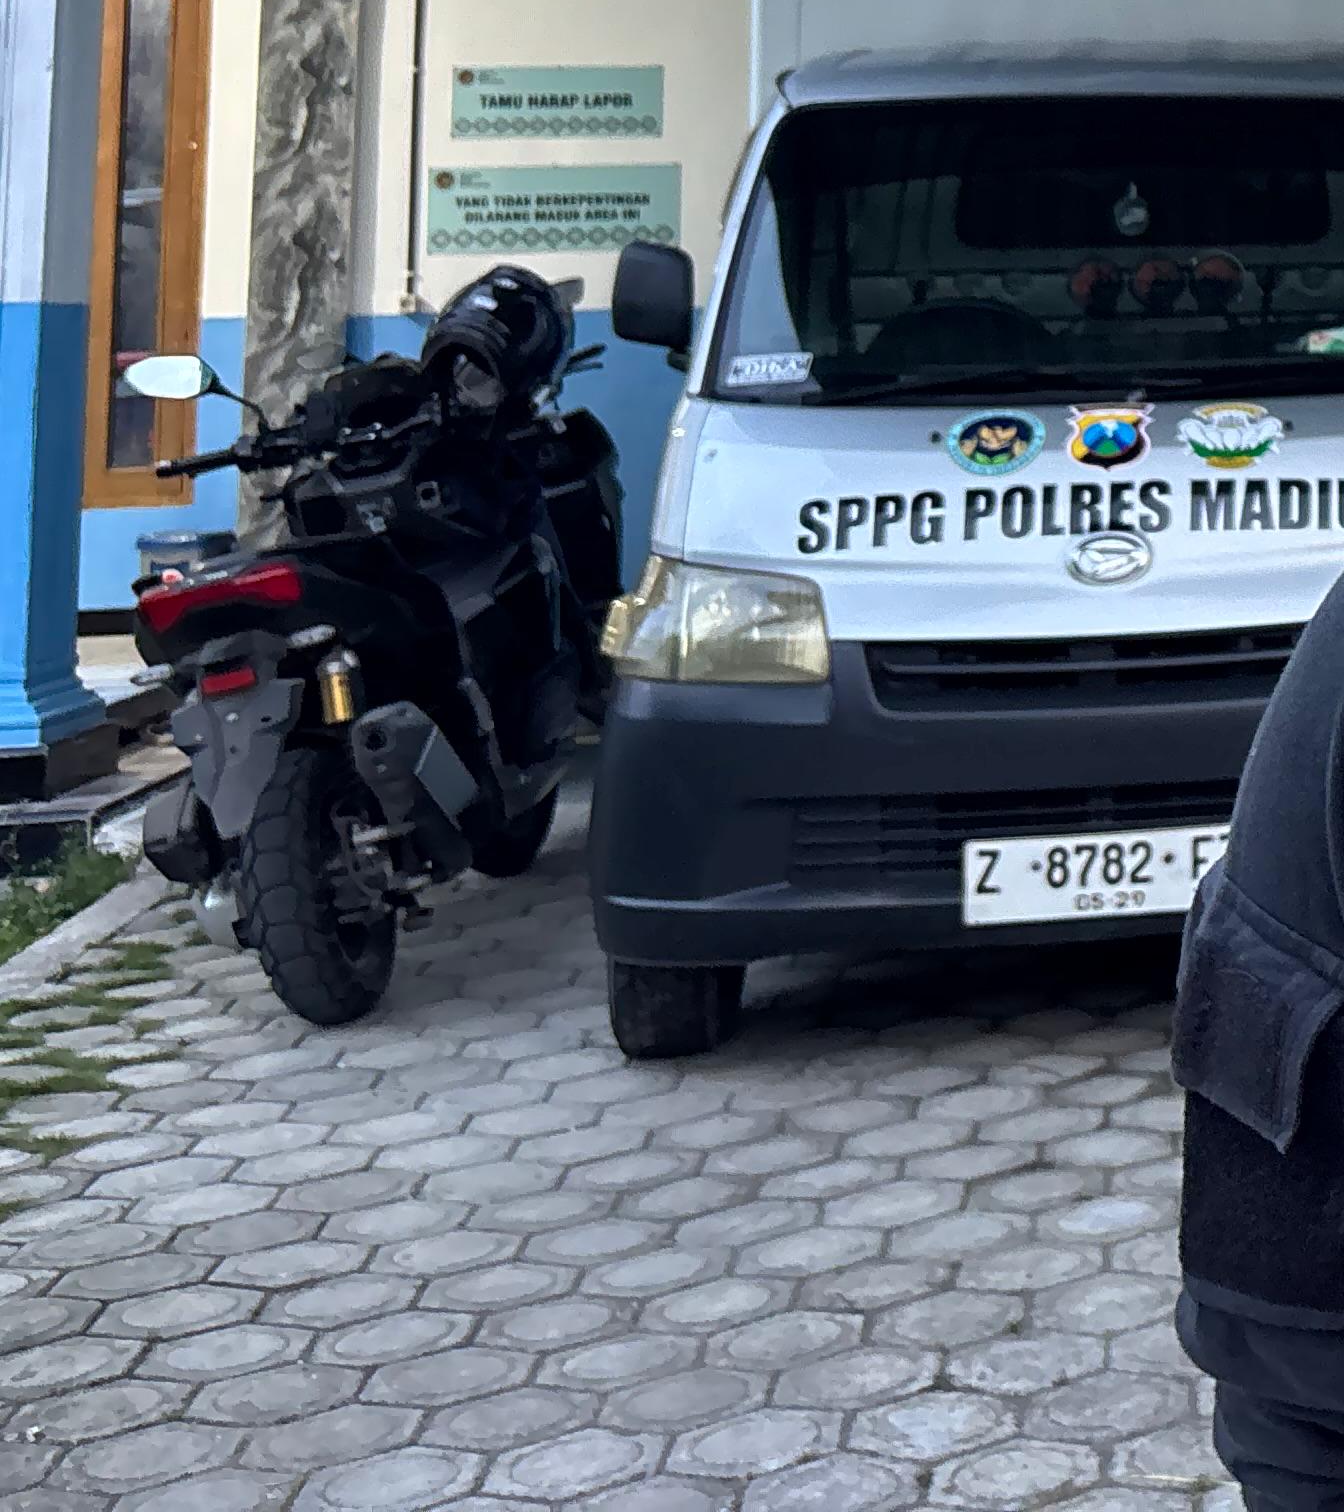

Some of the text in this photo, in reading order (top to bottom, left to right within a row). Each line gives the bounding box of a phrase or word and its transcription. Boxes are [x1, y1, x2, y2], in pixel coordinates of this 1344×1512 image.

[480, 93, 522, 109] TAMU
[584, 92, 633, 109] LAPOR
[797, 490, 944, 554] SPPG
[963, 480, 1171, 540] POLRES
[976, 849, 1000, 894] Z
[1047, 840, 1153, 888] 8782
